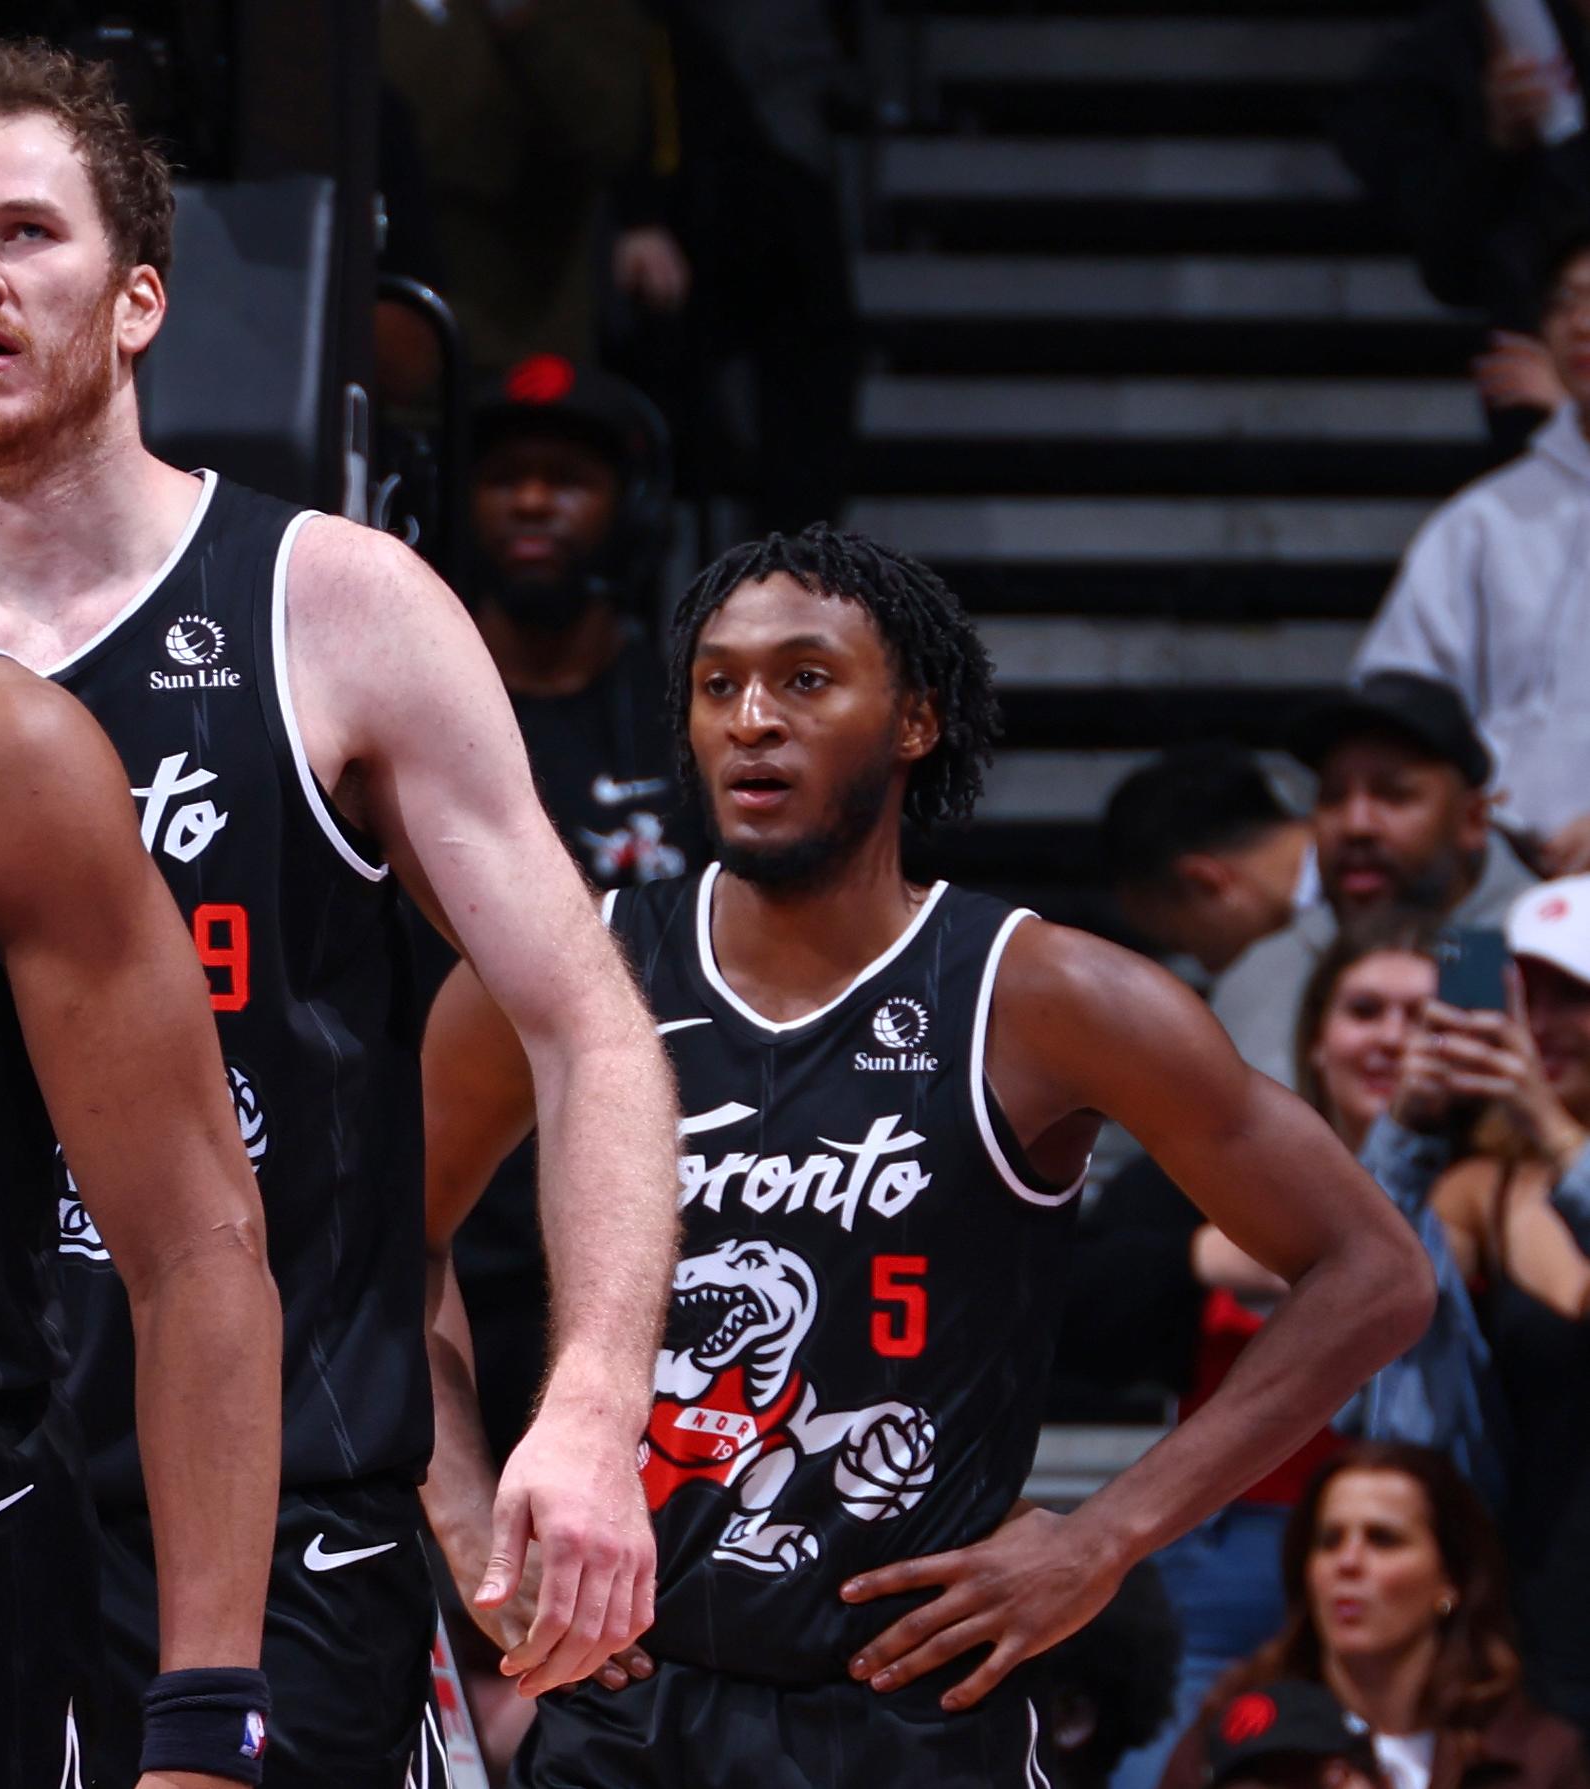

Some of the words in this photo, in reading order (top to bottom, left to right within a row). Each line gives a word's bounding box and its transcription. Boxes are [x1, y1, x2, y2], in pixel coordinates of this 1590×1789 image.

[150, 669, 195, 690] Sun
[197, 667, 241, 690] Life
[854, 1052, 896, 1071] Sun
[897, 1051, 938, 1072] Life
[870, 1255, 929, 1358] 5
[711, 1438, 734, 1461] 19
